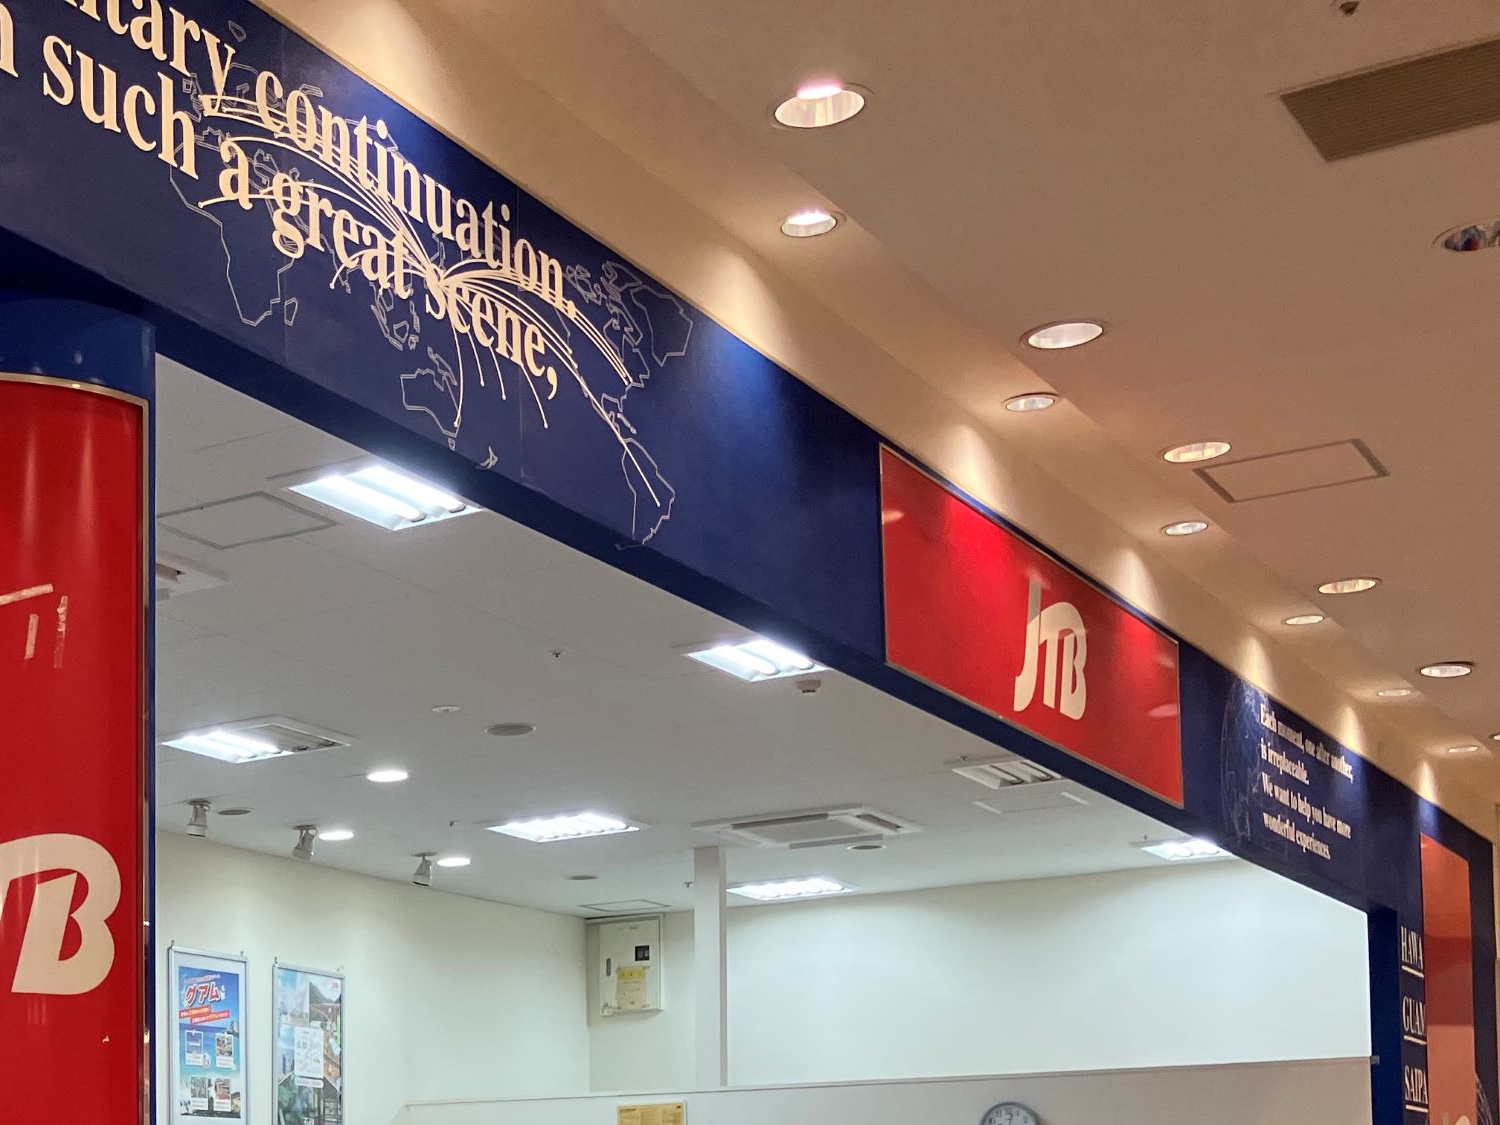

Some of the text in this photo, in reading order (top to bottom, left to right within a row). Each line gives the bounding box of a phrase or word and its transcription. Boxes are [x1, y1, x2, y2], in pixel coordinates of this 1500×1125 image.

[42, 34, 202, 179] such
[218, 137, 253, 210] a
[271, 172, 410, 300] great
[424, 261, 558, 401] scene,
[255, 70, 577, 320] continuation.
[1013, 579, 1088, 721] JTB
[185, 981, 222, 1008] グアム
